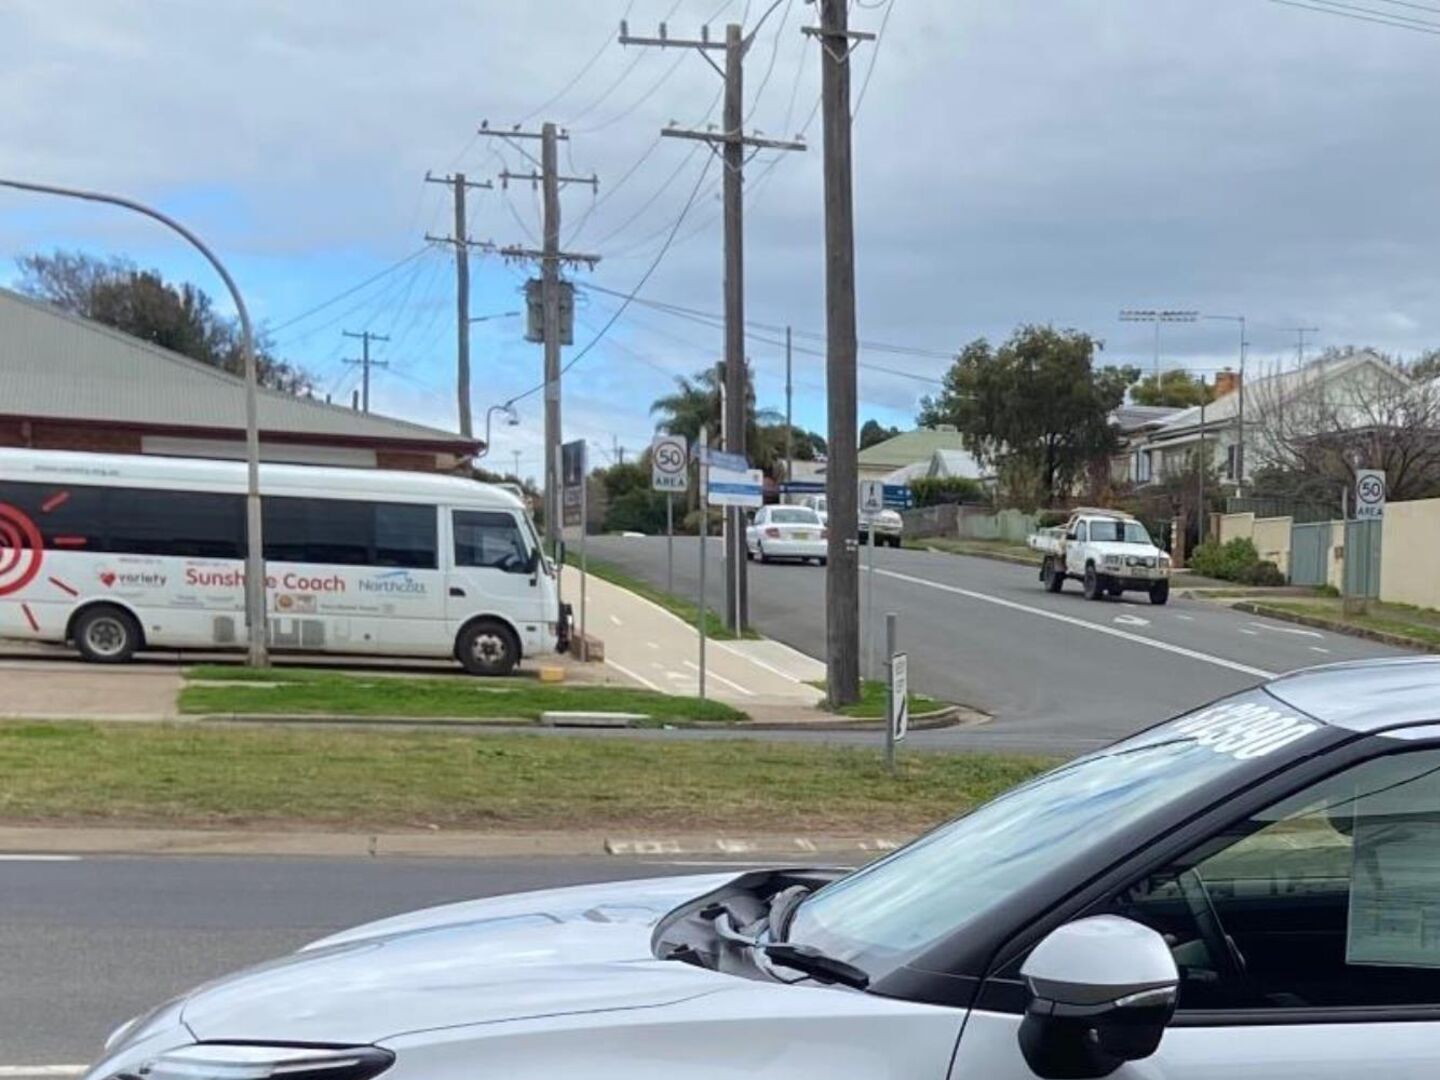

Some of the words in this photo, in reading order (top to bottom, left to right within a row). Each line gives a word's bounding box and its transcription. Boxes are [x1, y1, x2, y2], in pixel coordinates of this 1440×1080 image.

[659, 450, 681, 466] 50
[655, 476, 685, 487] AREA
[1362, 482, 1380, 497] 50
[119, 572, 167, 587] variety
[186, 568, 277, 589] Sunshe
[283, 572, 346, 592] Coach
